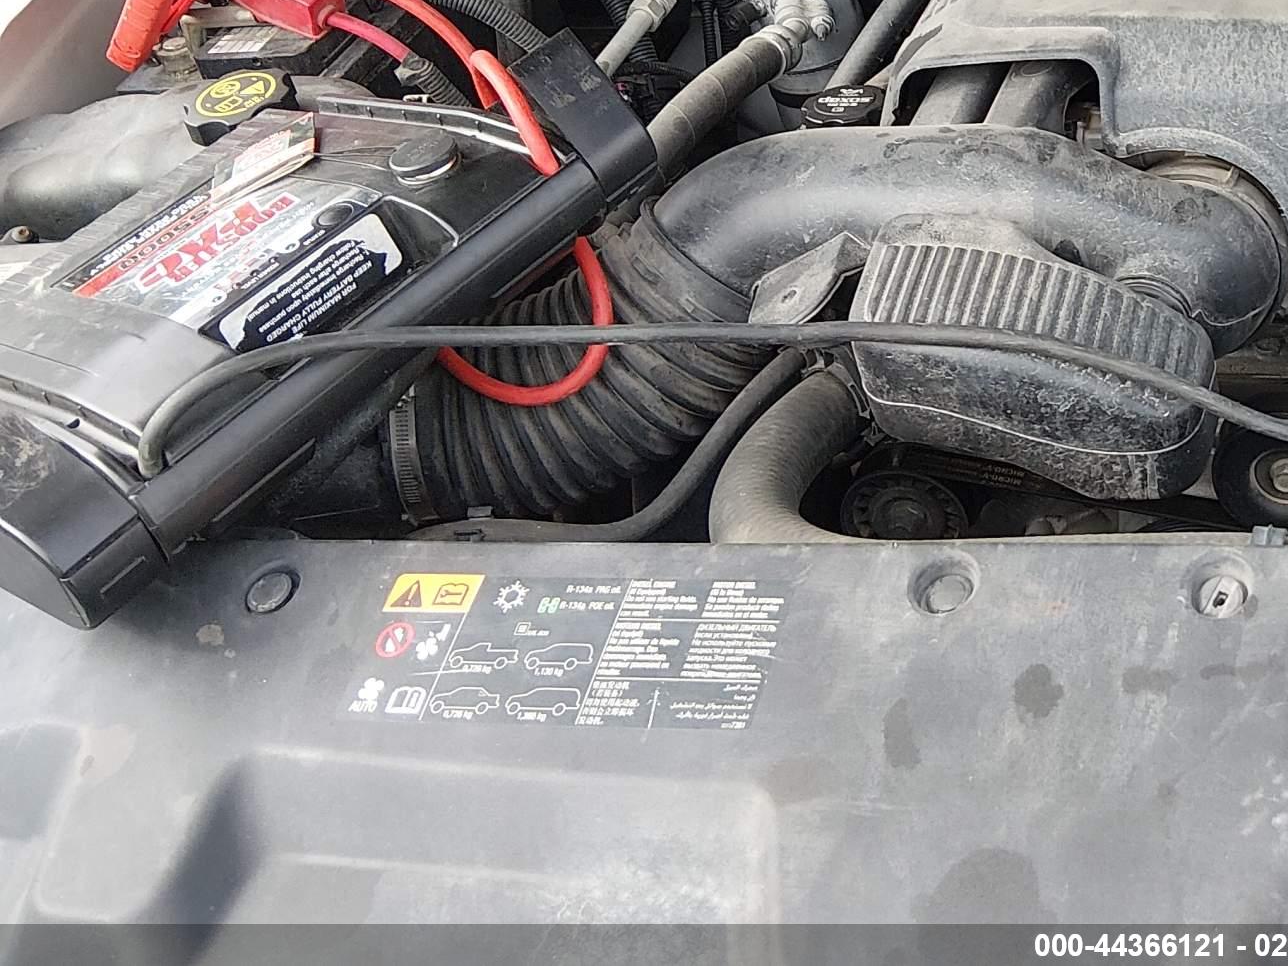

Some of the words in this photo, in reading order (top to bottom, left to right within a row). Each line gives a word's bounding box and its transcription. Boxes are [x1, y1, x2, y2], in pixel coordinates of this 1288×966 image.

[166, 194, 296, 283] BOOSTER
[335, 239, 355, 257] Follow
[309, 253, 336, 276] charging
[330, 245, 360, 270] Recharge
[335, 253, 365, 277] Recharge
[317, 266, 332, 280] after
[352, 260, 373, 278] KEEP
[275, 272, 311, 301] instructions
[291, 287, 303, 300] use
[301, 273, 337, 302] immediately
[302, 276, 318, 291] each
[322, 274, 354, 300] BATTERY
[341, 281, 357, 297] FOR
[247, 302, 270, 322] manual
[285, 297, 302, 313] upon
[299, 297, 323, 317] FULLY
[306, 293, 342, 322] MAXIMUM
[257, 308, 287, 334] purchase
[265, 313, 301, 342] CHARGED
[291, 319, 307, 334] LIFE
[348, 700, 378, 713] AUTO
